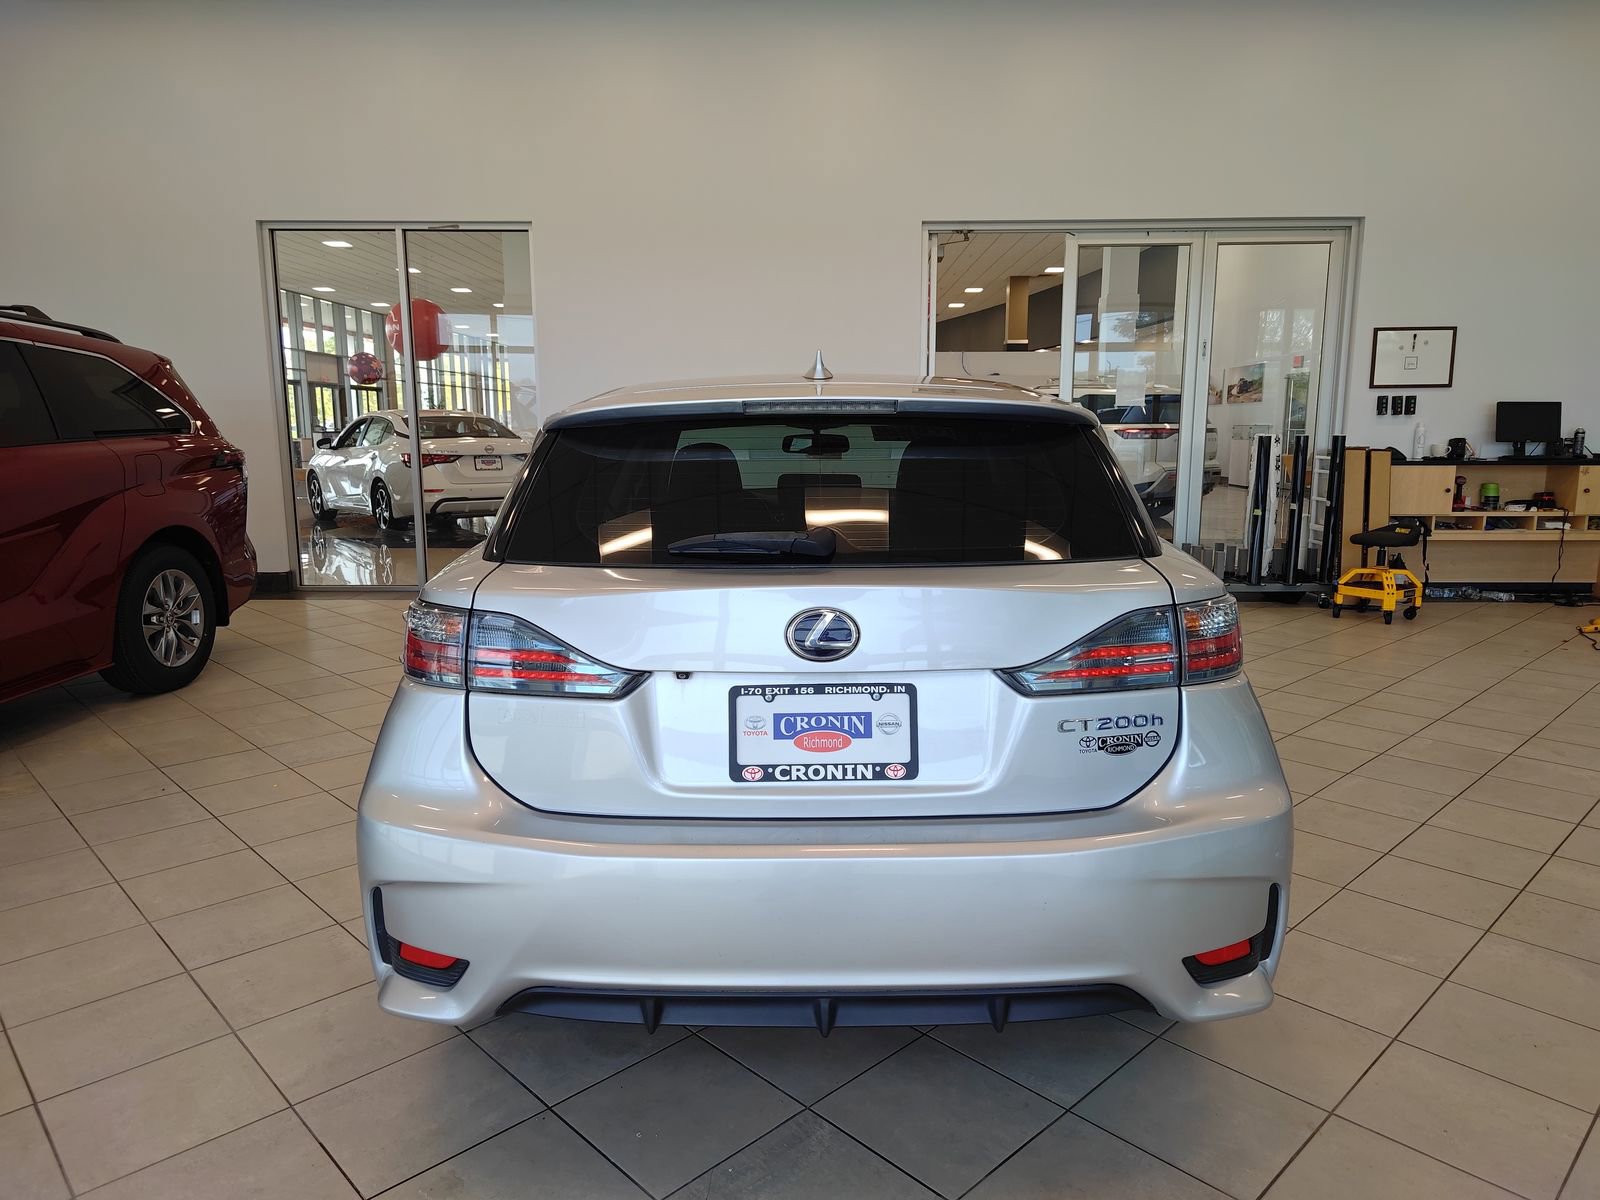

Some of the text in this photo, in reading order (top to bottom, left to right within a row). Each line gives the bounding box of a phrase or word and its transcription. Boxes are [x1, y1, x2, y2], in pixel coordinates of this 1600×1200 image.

[741, 687, 762, 695] I-70
[765, 687, 789, 695] EXIT
[794, 686, 815, 694] 156
[893, 685, 906, 693] IN
[780, 715, 866, 736] CRONIN
[803, 737, 843, 749] Richmond
[1098, 733, 1142, 747] CRONIN
[774, 764, 873, 781] CRONIN
